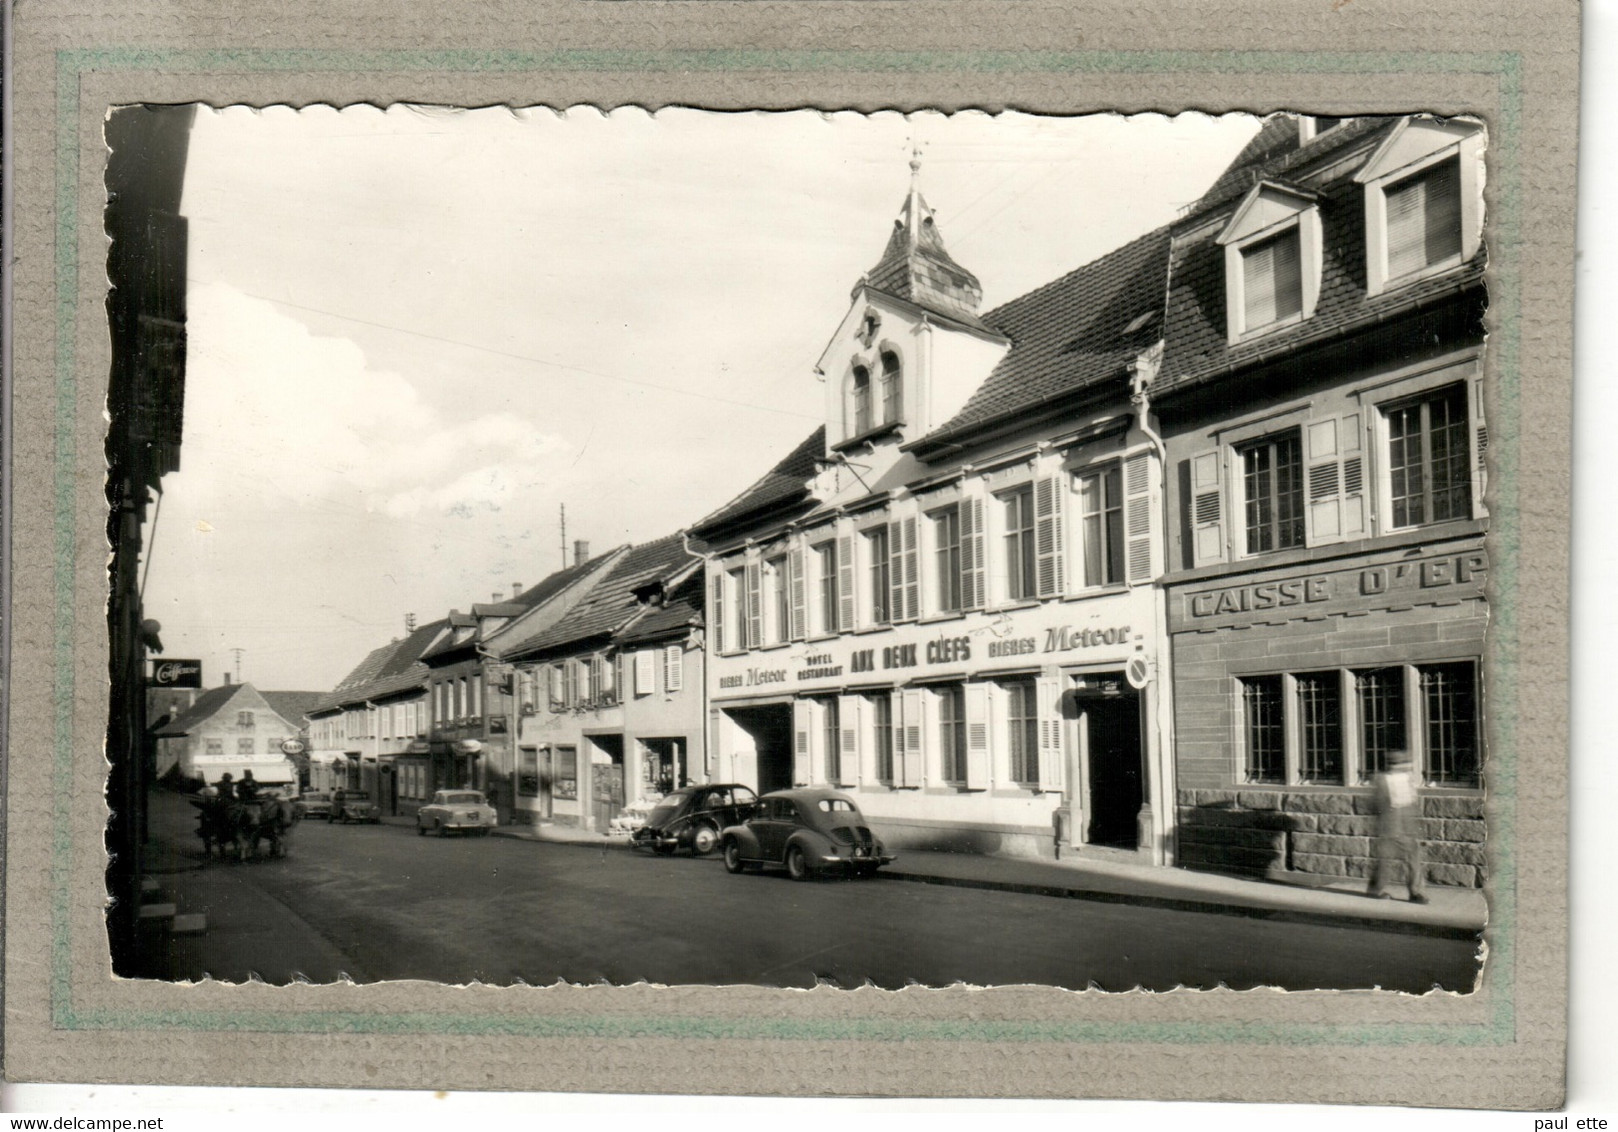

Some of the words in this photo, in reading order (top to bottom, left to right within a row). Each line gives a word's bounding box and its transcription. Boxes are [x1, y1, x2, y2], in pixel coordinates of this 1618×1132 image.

[1191, 576, 1332, 618] CAISSE
[797, 665, 844, 681] RESTAURANT
[851, 649, 874, 673] AUX
[882, 643, 918, 669] DEUX
[926, 635, 971, 664] CLEFS
